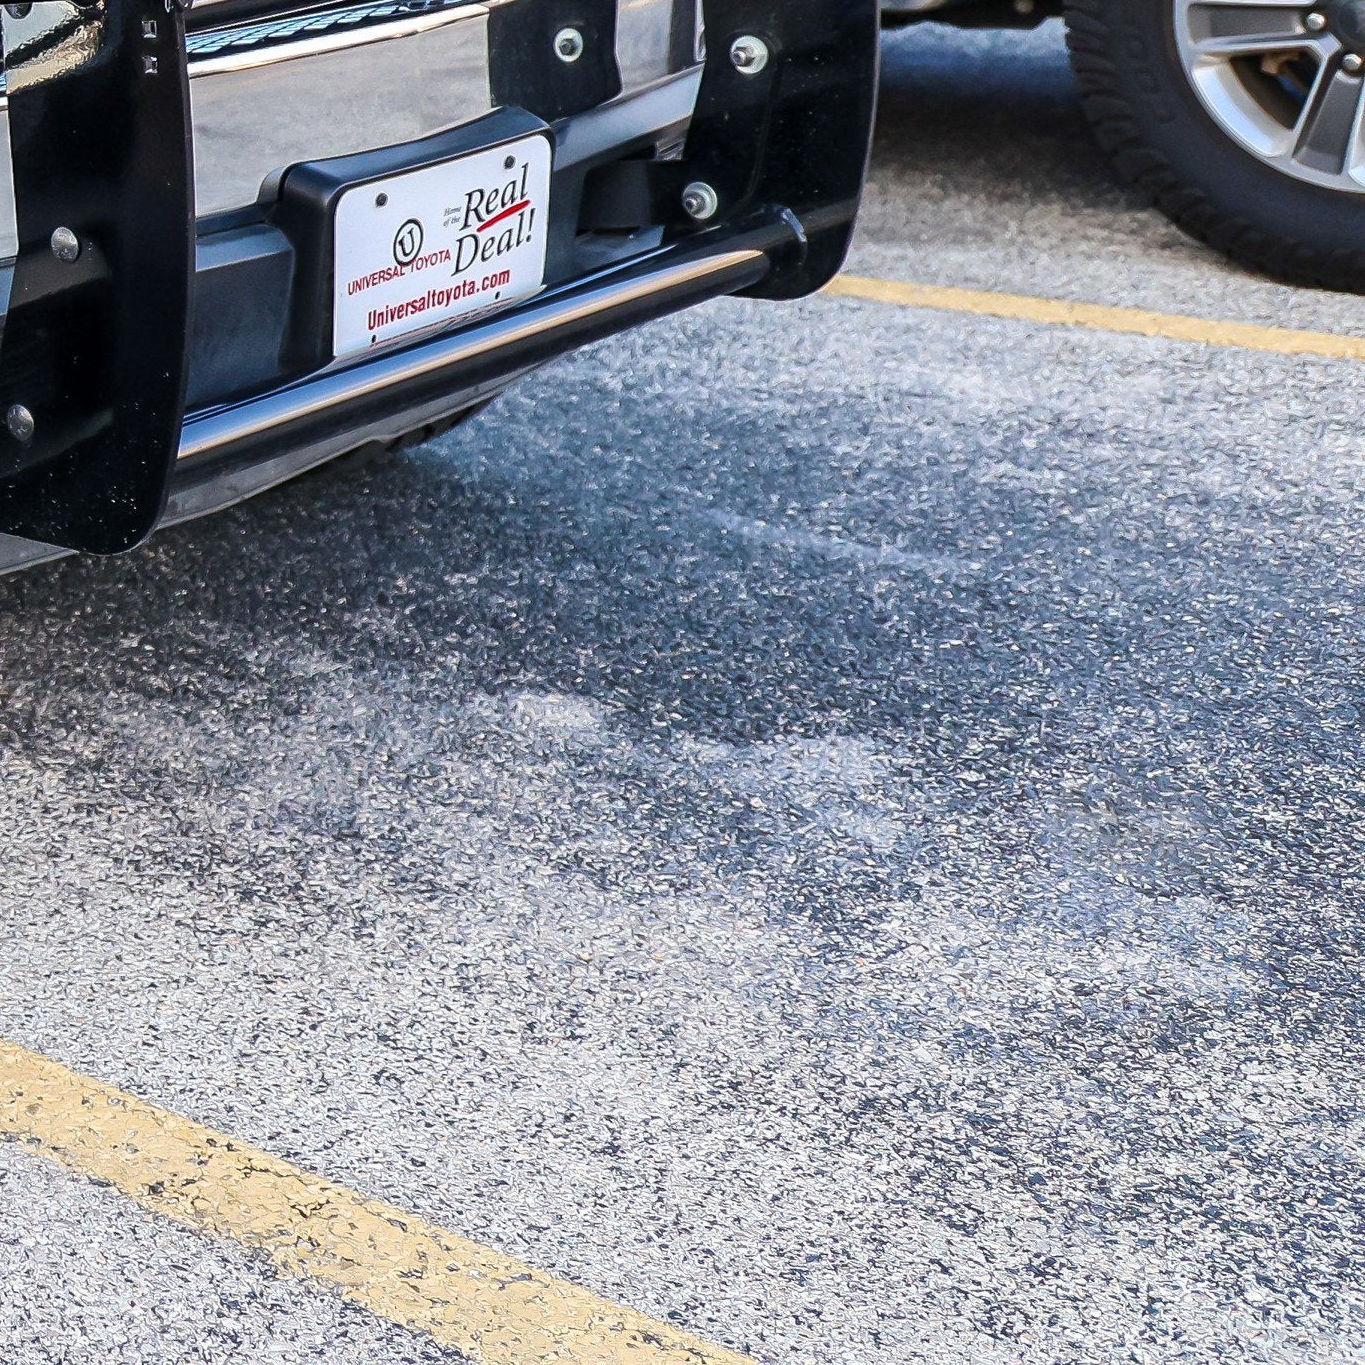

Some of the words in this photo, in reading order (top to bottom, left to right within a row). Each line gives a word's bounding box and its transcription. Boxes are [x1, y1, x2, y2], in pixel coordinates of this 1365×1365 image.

[459, 162, 530, 231] Real
[348, 264, 406, 295] UNIVERSAL
[410, 249, 451, 273] TOYOTA
[450, 208, 536, 277] Deal!
[368, 269, 511, 330] Universaltoyota.com
